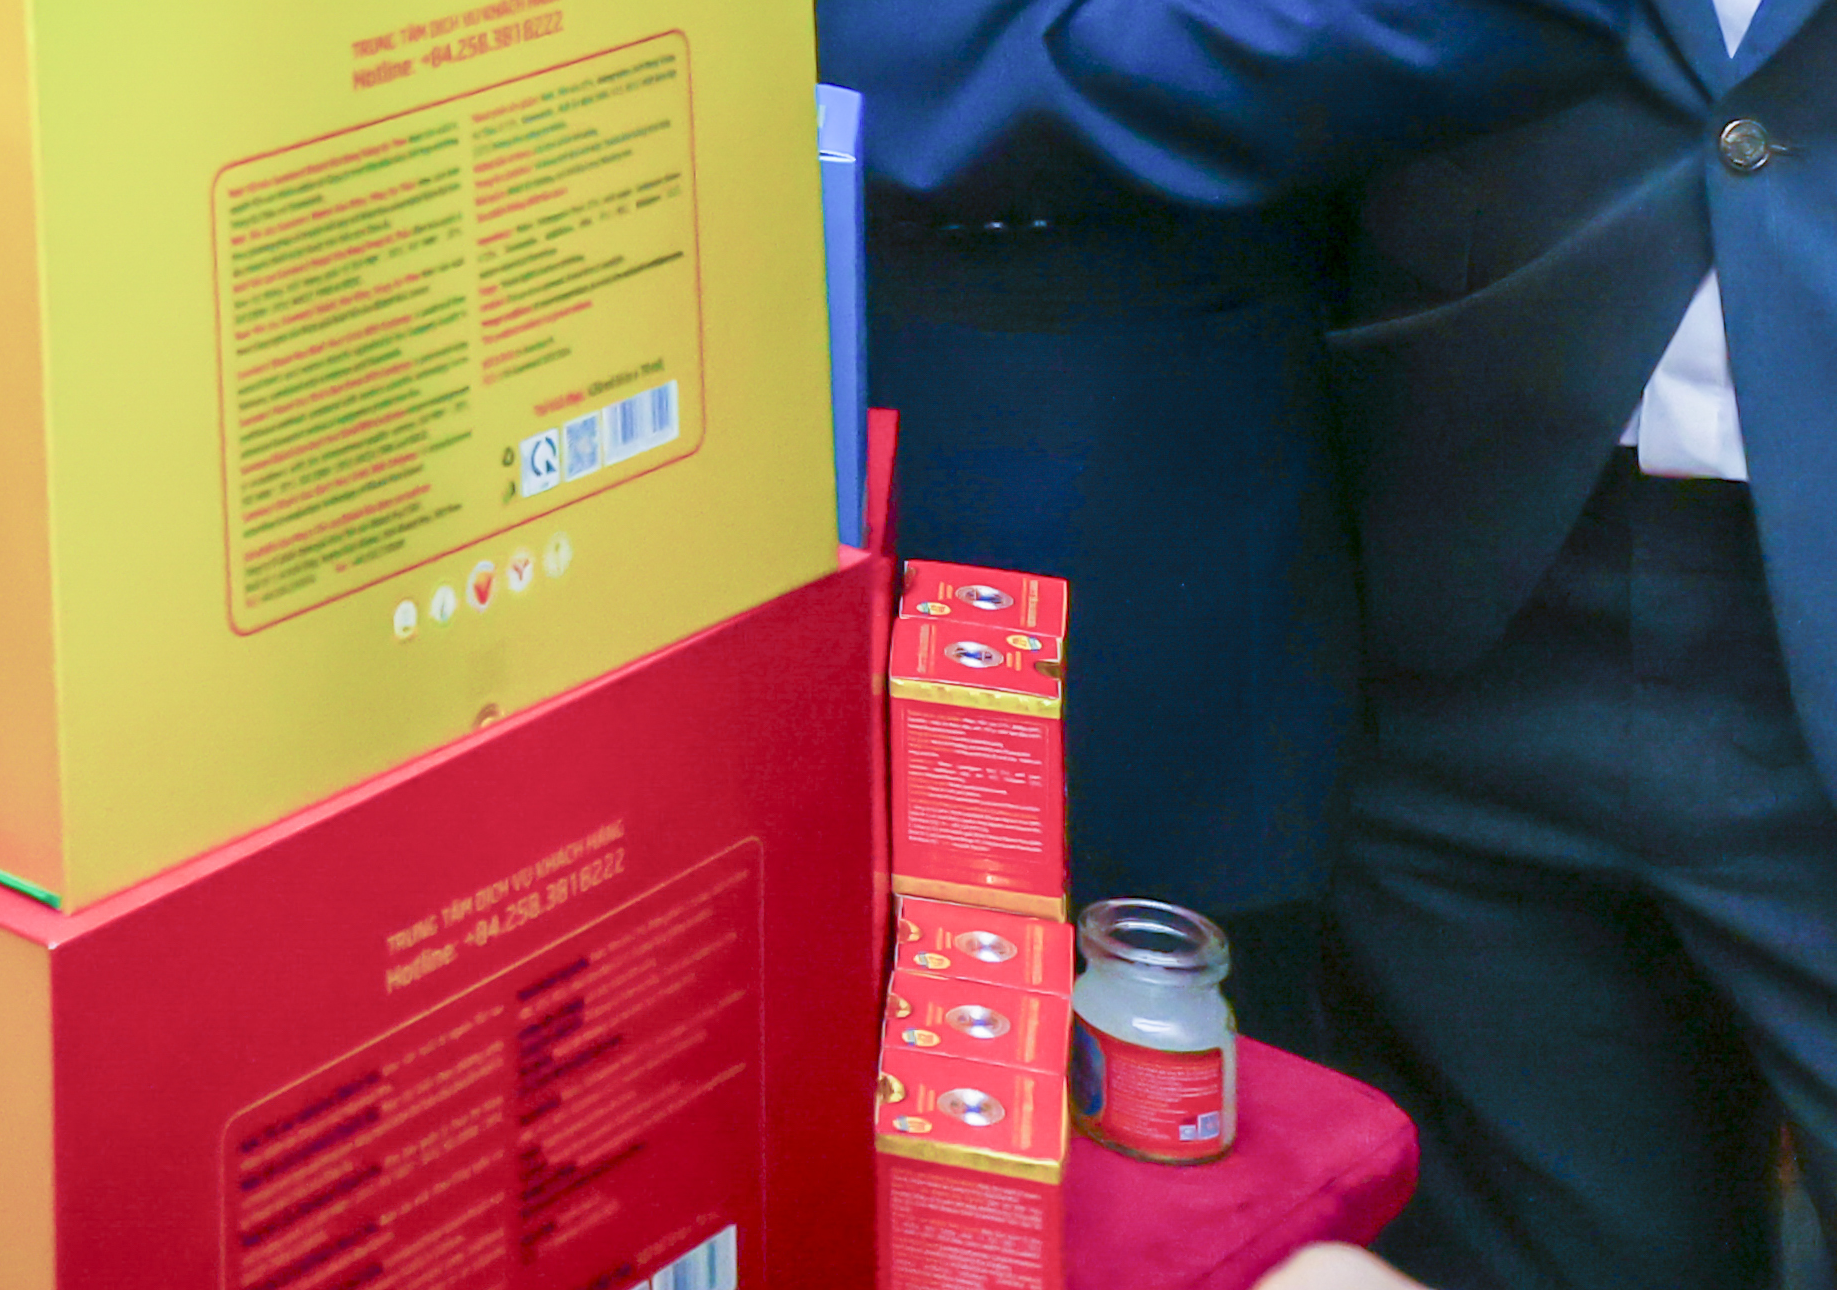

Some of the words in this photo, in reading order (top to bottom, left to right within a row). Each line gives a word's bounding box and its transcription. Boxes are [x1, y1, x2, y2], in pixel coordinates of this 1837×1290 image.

[352, 32, 396, 59] TRUNG
[387, 913, 438, 956] TRUNG
[386, 941, 458, 995] Hotline:
